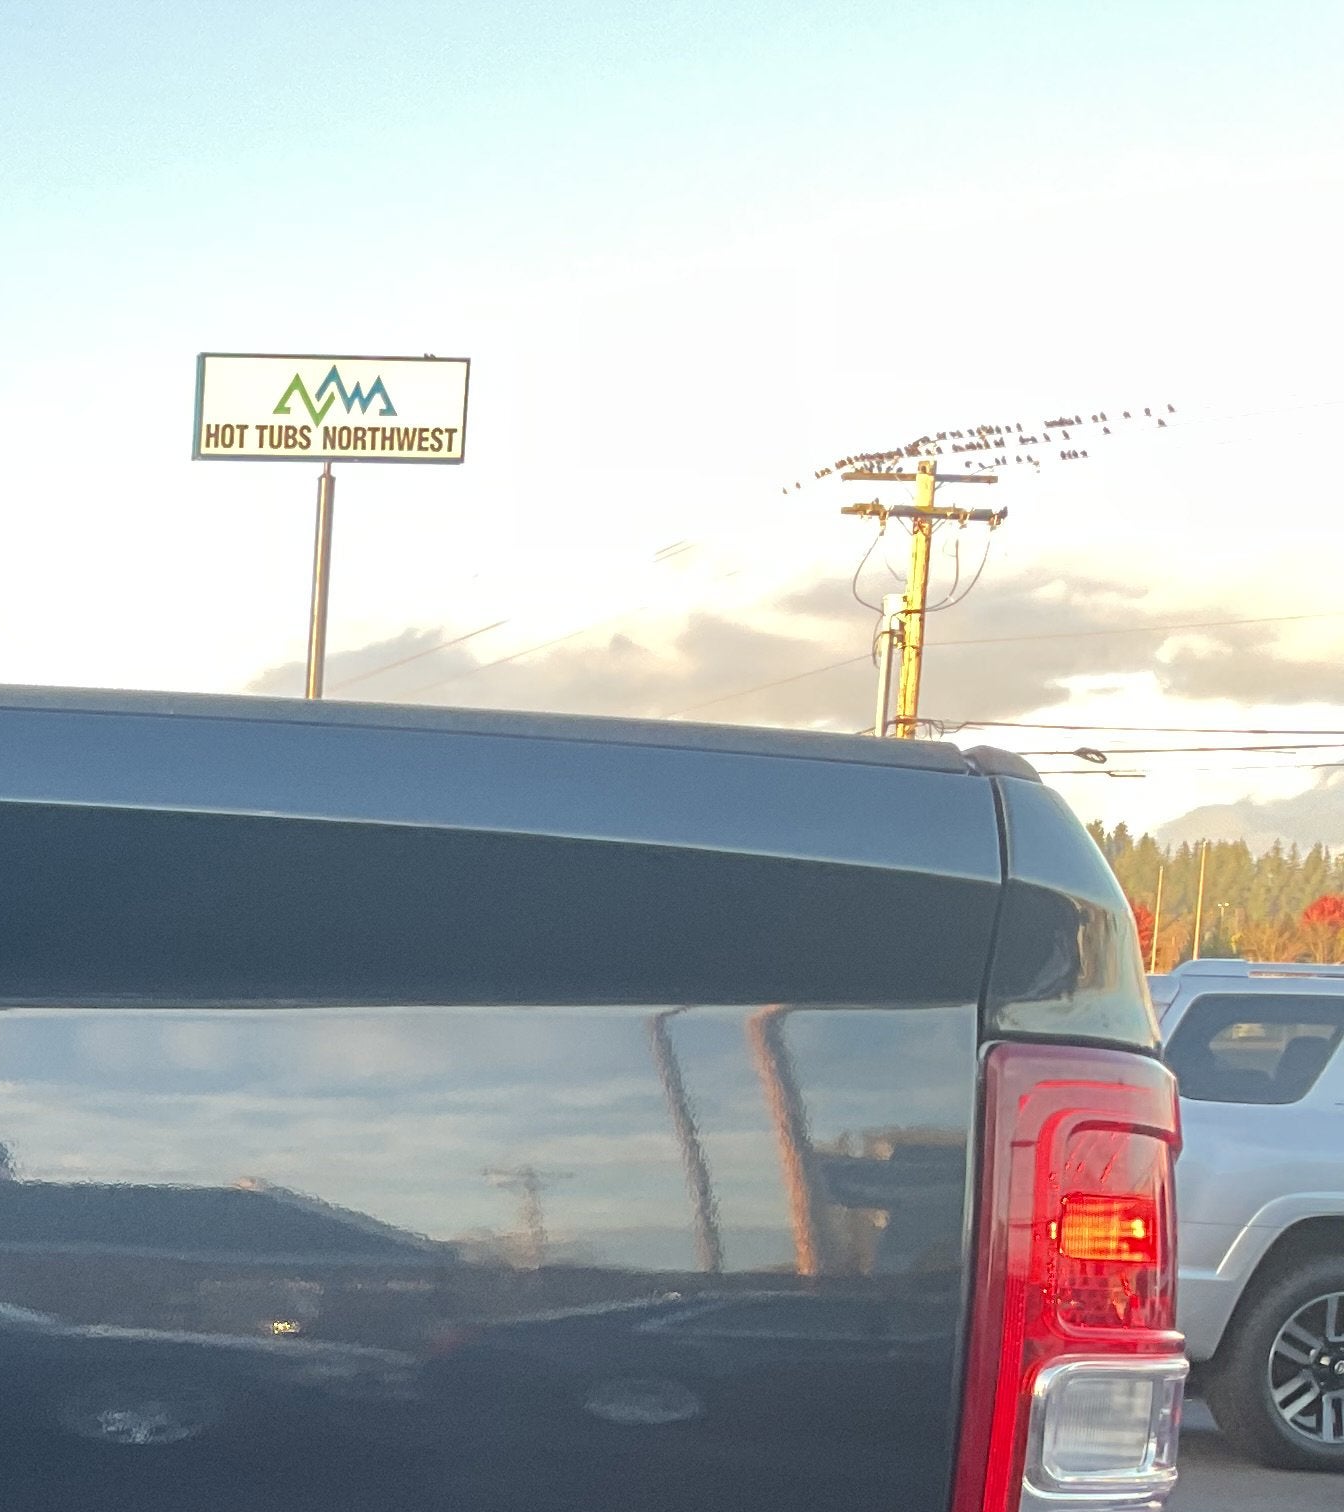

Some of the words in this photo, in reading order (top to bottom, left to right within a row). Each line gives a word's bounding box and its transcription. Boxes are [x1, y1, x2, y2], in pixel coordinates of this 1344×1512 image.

[205, 424, 249, 449] HOT
[255, 424, 312, 450] TUBS
[323, 426, 458, 452] NORTHWEST
